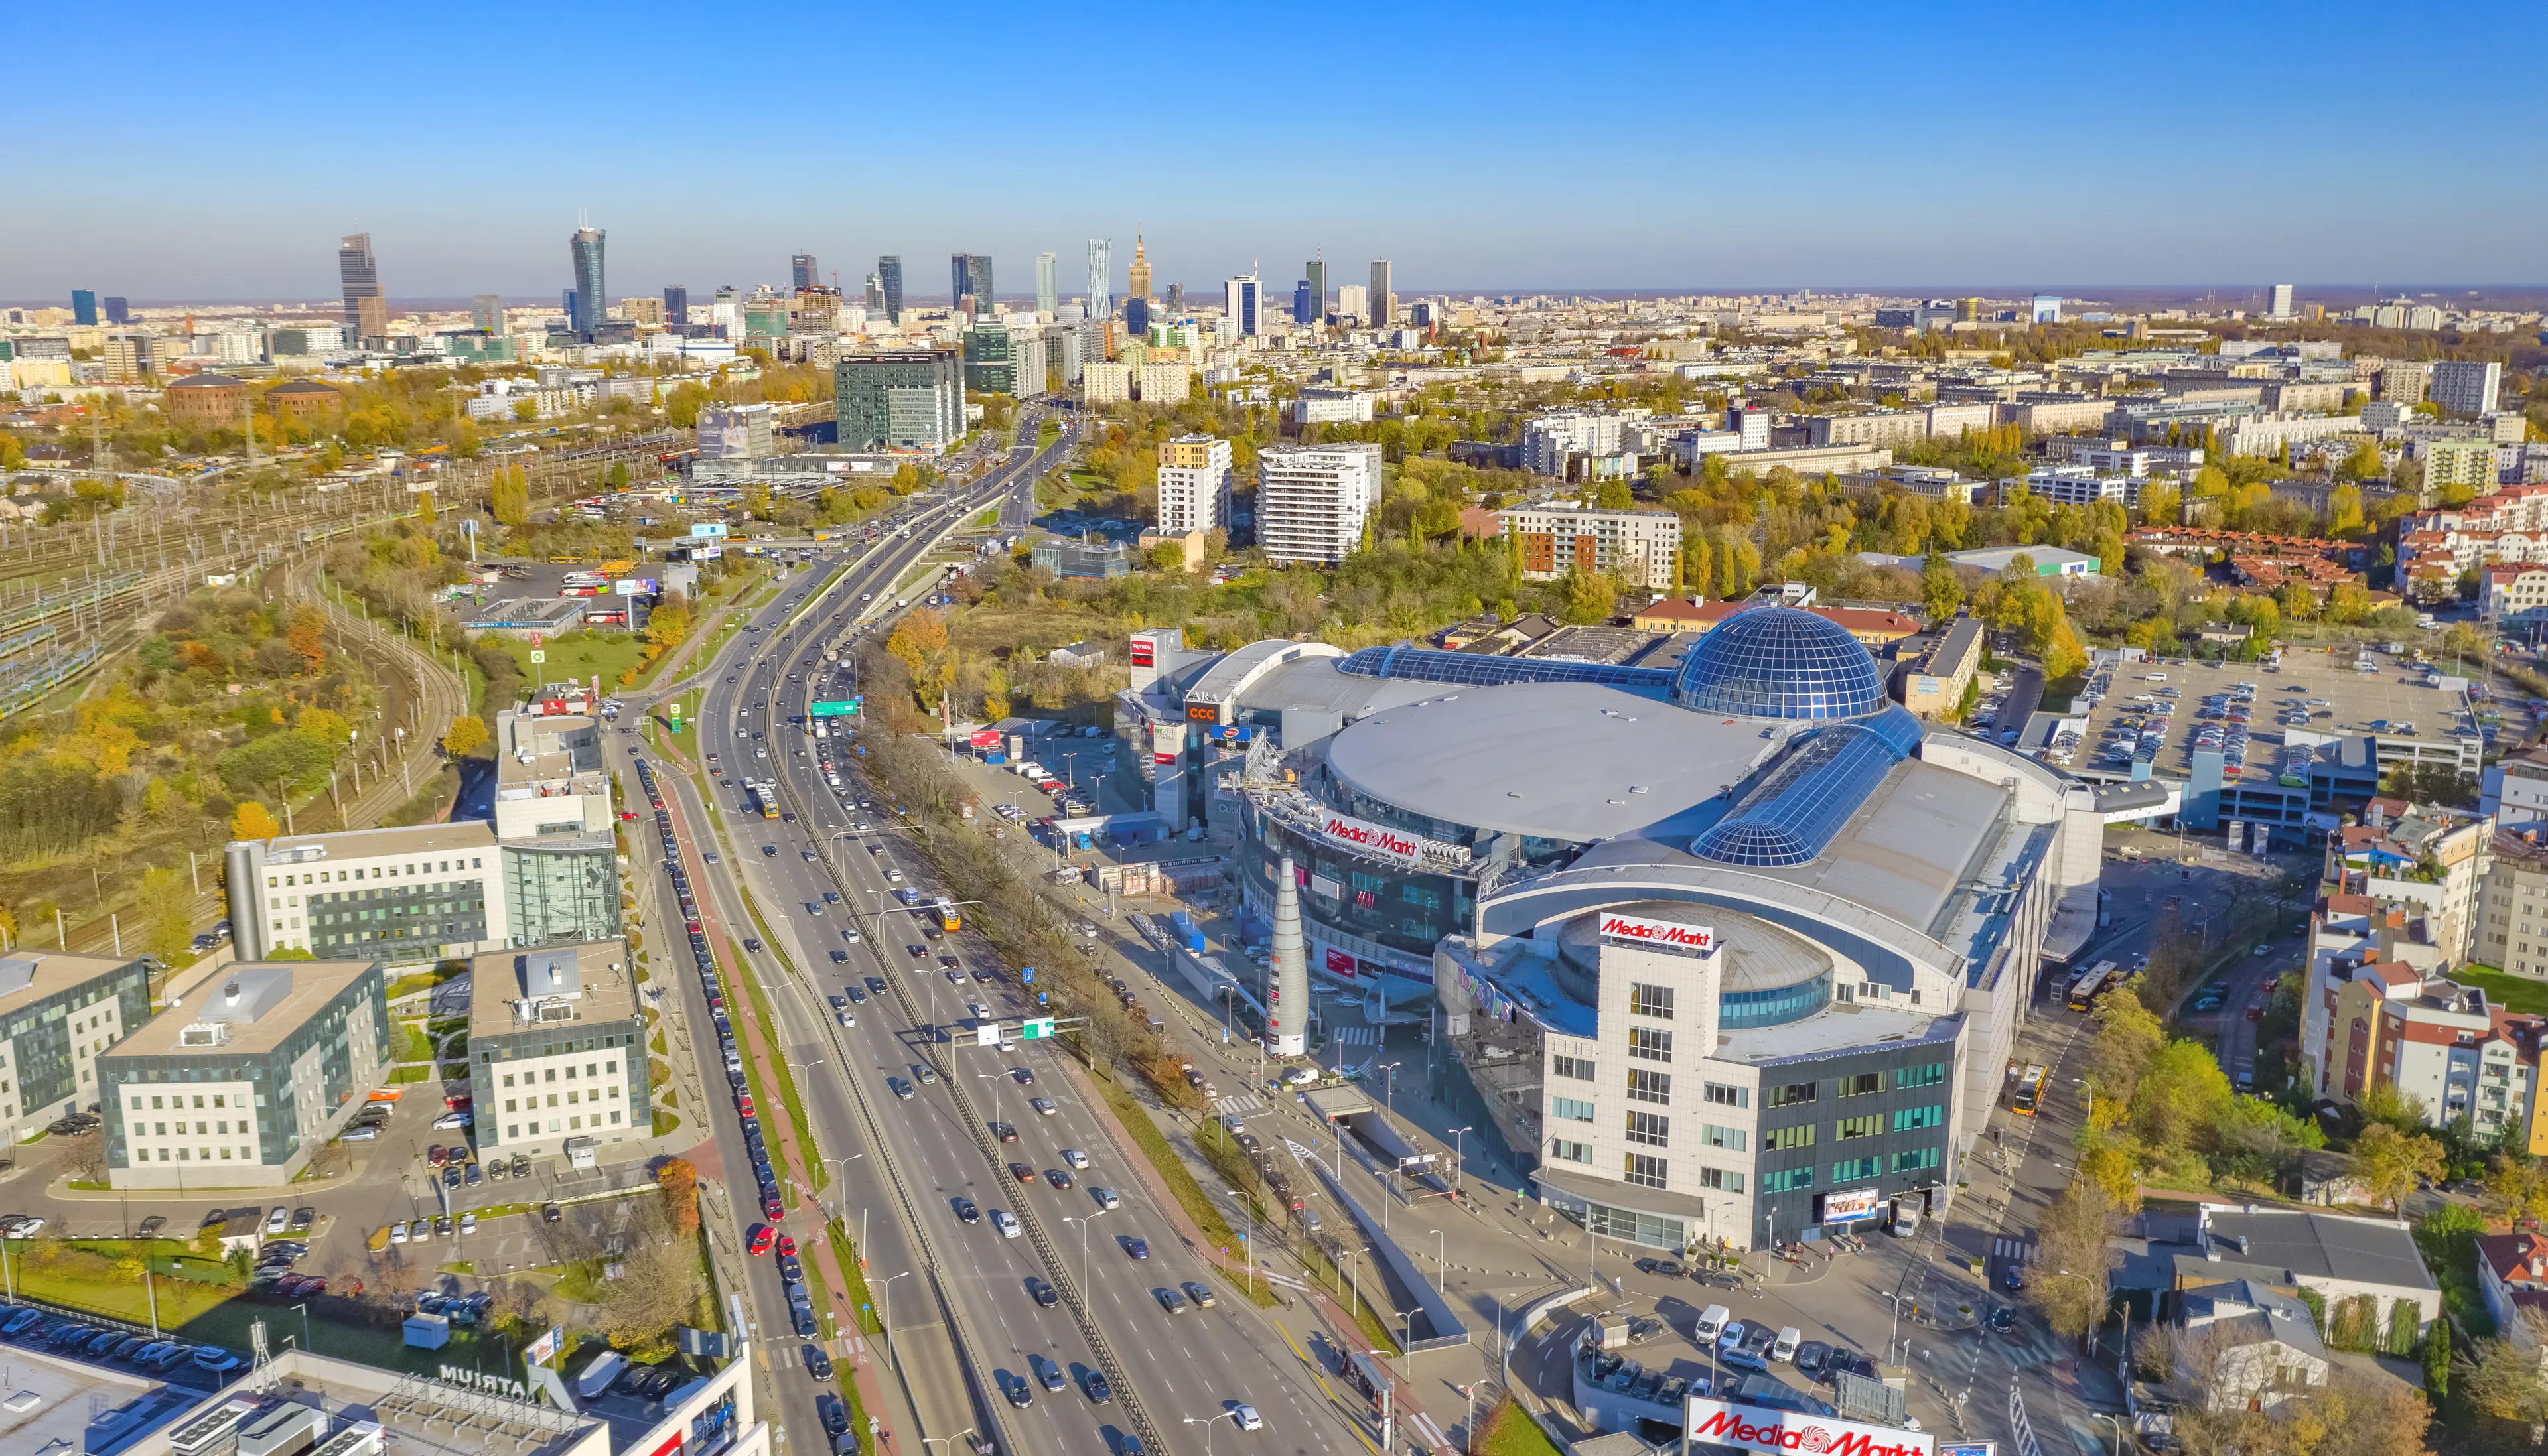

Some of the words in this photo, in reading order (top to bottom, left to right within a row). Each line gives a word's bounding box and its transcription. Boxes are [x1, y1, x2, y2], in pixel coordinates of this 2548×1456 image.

[1185, 689, 1220, 702] ZARA
[1190, 708, 1215, 720] CCC
[1324, 819, 1368, 844] Media
[1376, 832, 1417, 857] Markt
[1357, 891, 1374, 909] H&M
[1601, 919, 1653, 938] Media
[1663, 927, 1710, 946] Markt
[1695, 1411, 1801, 1450] Media
